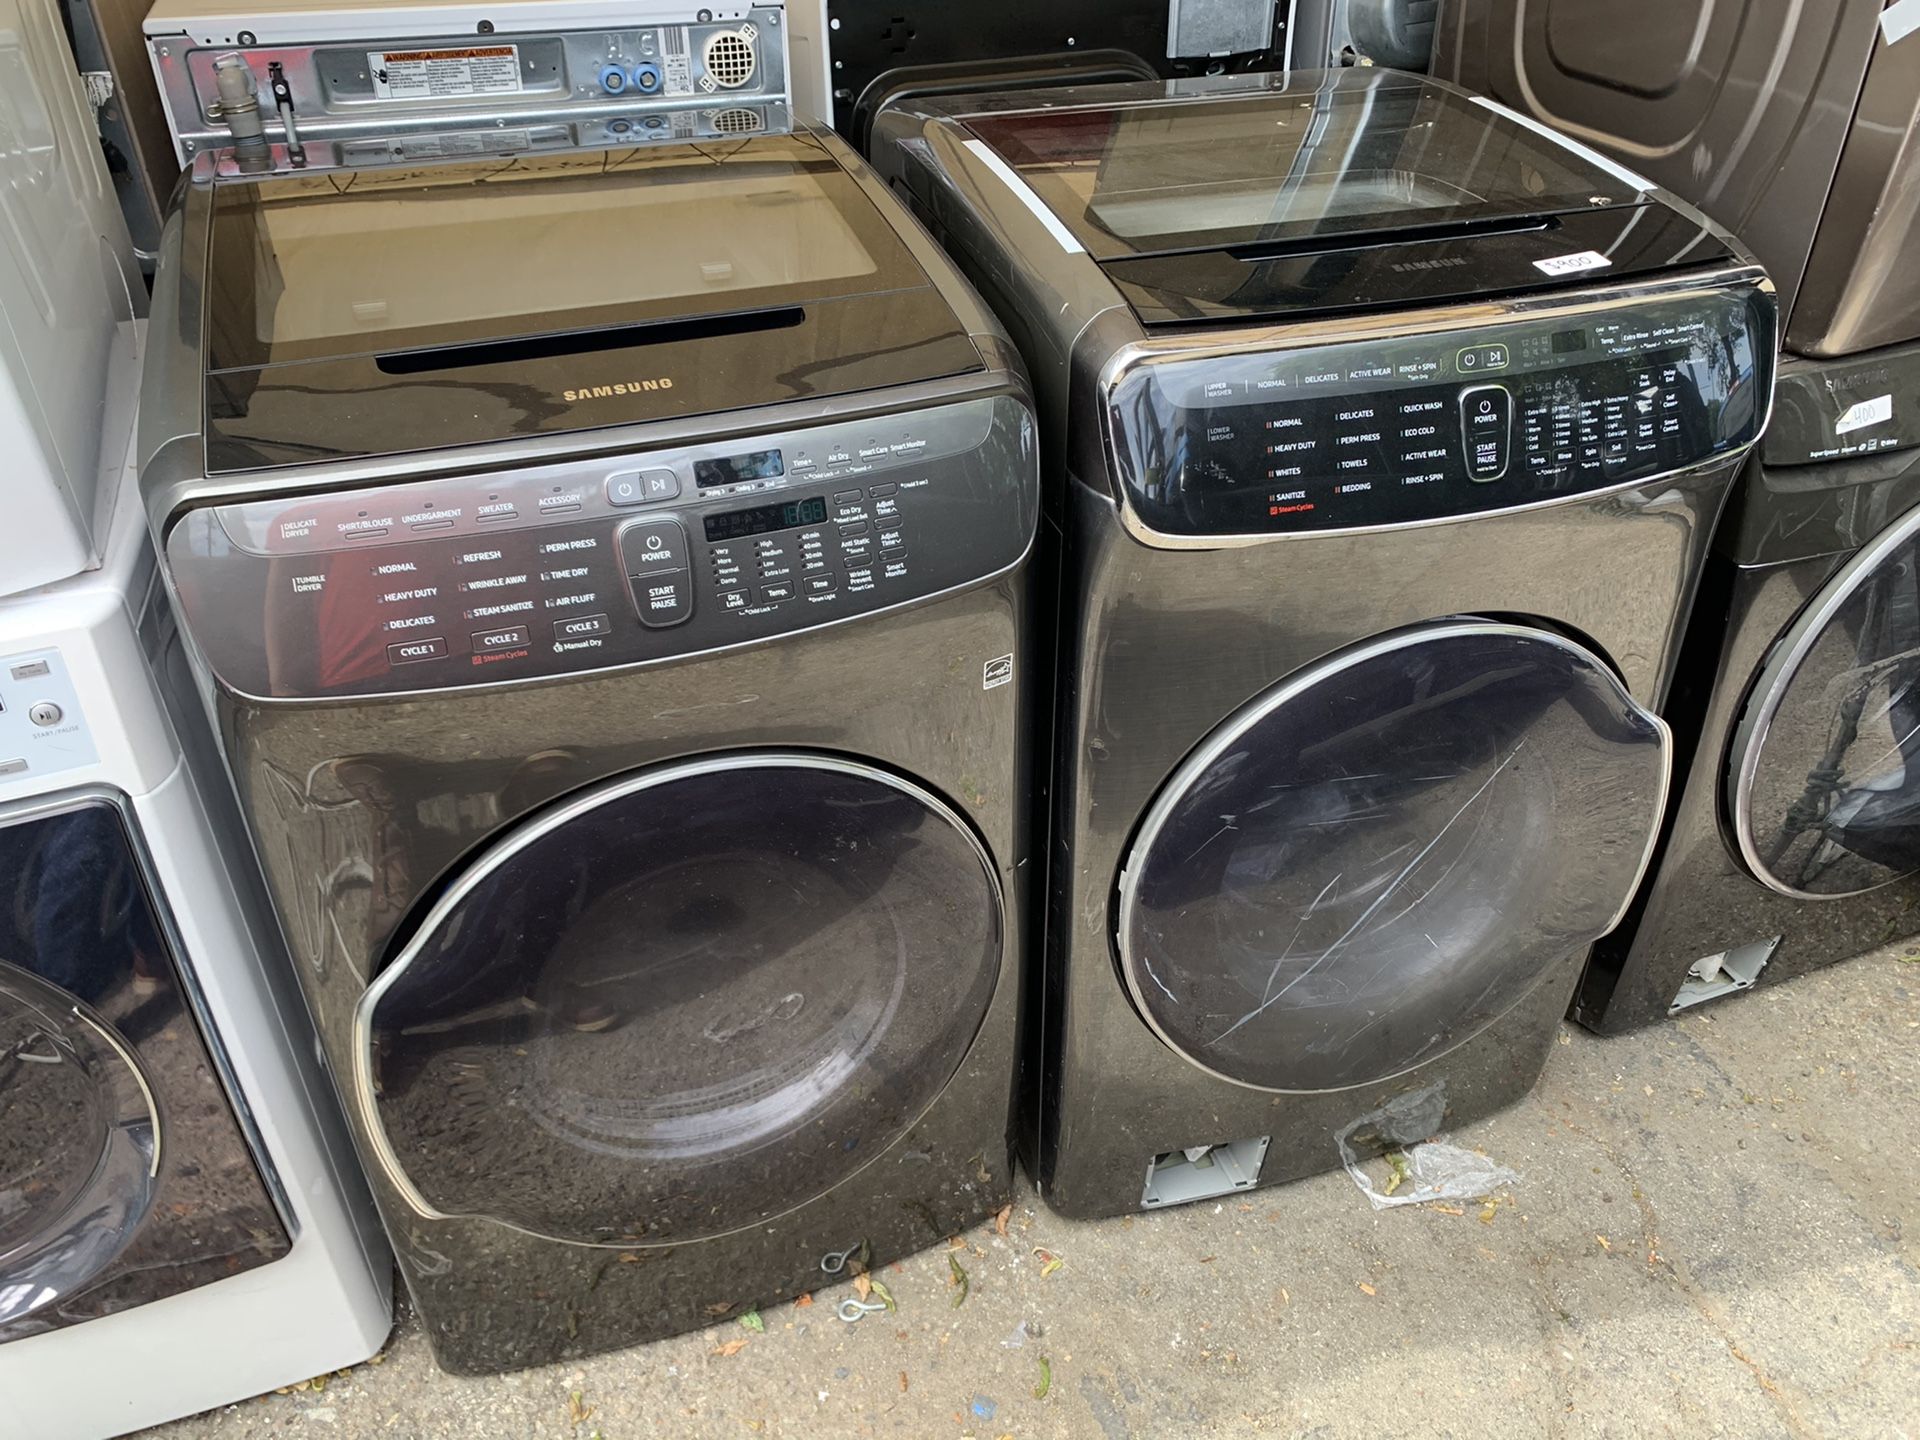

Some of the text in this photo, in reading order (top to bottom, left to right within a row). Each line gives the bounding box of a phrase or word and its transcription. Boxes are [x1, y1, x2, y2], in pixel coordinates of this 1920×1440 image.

[1350, 367, 1392, 379] ACTIVE WEAR
[1400, 364, 1417, 373] RINSE
[1423, 362, 1437, 371] SPIN
[1664, 369, 1676, 377] Delay
[1305, 373, 1339, 384] DELICATES
[563, 378, 673, 401] SAMSUNG
[1208, 382, 1227, 390] UPPER
[1258, 380, 1287, 389] NORMAL
[1208, 389, 1232, 398] WASHER
[1404, 402, 1443, 413] QUICK WASH
[1340, 409, 1374, 420] DELICATES
[1475, 414, 1497, 424] POWER
[1273, 418, 1303, 428] NORMAL
[1664, 418, 1678, 426] Smart
[1210, 426, 1231, 434] LOWER
[1405, 426, 1435, 437] ECO COLD
[1663, 424, 1679, 432] Control
[1211, 433, 1235, 441] WASHER
[1341, 433, 1381, 445] PERM PRESS
[890, 440, 926, 451] Smart Monitor
[1275, 441, 1316, 453] HEAVY DUTY
[1477, 442, 1497, 453] START
[1612, 443, 1622, 451] Soil
[838, 453, 849, 461] Dry
[859, 446, 888, 457] Smart Care
[1406, 449, 1447, 460] ACTIVE WEAR
[1341, 459, 1368, 469] TOWELS
[1477, 454, 1497, 464] PAUSE
[1275, 467, 1301, 477] WHITES
[1406, 475, 1424, 484] RINSE
[1429, 473, 1444, 482] SPIN
[1342, 482, 1371, 493] BEDDING
[539, 494, 581, 507] ACCESSORY
[1277, 490, 1306, 501] SANITIZE
[478, 502, 515, 515] SWEATER
[876, 499, 895, 509] Adjust
[1279, 503, 1314, 514] Steam Cycles
[402, 508, 462, 524] UNDERGARMENT
[840, 508, 851, 516] Eco
[284, 519, 318, 530] DELICATE
[337, 517, 394, 532] SHIRT/BLOUSE
[286, 528, 310, 539] DRYER
[881, 531, 899, 541] Adjust
[546, 538, 597, 553] PERM PRESS
[760, 540, 773, 548] High
[854, 538, 870, 546] Static
[463, 550, 502, 563] REFRESH
[641, 550, 672, 562] POWER
[715, 547, 729, 555] Very
[761, 548, 783, 557] Medium
[378, 562, 417, 574] NORMAL
[719, 566, 740, 575] Normal
[886, 562, 904, 571] Smart
[551, 567, 589, 580] TIME DRY
[765, 569, 779, 577] Extra
[849, 569, 871, 578] Wrinkle
[885, 569, 907, 578] Monitor
[296, 574, 326, 585] TUMBLE
[468, 574, 528, 590] WRINKLE AWAY
[720, 577, 737, 585] Damp
[812, 581, 829, 589] Time
[850, 576, 872, 585] Prevent
[297, 583, 322, 592] DRYER
[649, 585, 675, 597] START
[768, 588, 788, 597] Temp.
[385, 587, 438, 602] HEAVY DUTY
[556, 593, 596, 607] AIR FLUFF
[728, 594, 740, 602] Dry
[473, 600, 534, 617] STEAM SANITIZE
[651, 599, 677, 610] PAUSE
[726, 599, 745, 608] Level
[390, 615, 436, 629] DELICATES
[566, 620, 599, 633] CYCLE 3
[484, 632, 519, 646] CYCLE 2
[564, 638, 602, 651] Manual Dry
[400, 644, 435, 657] CYCLE 1
[483, 649, 529, 663] Steam Cycles
